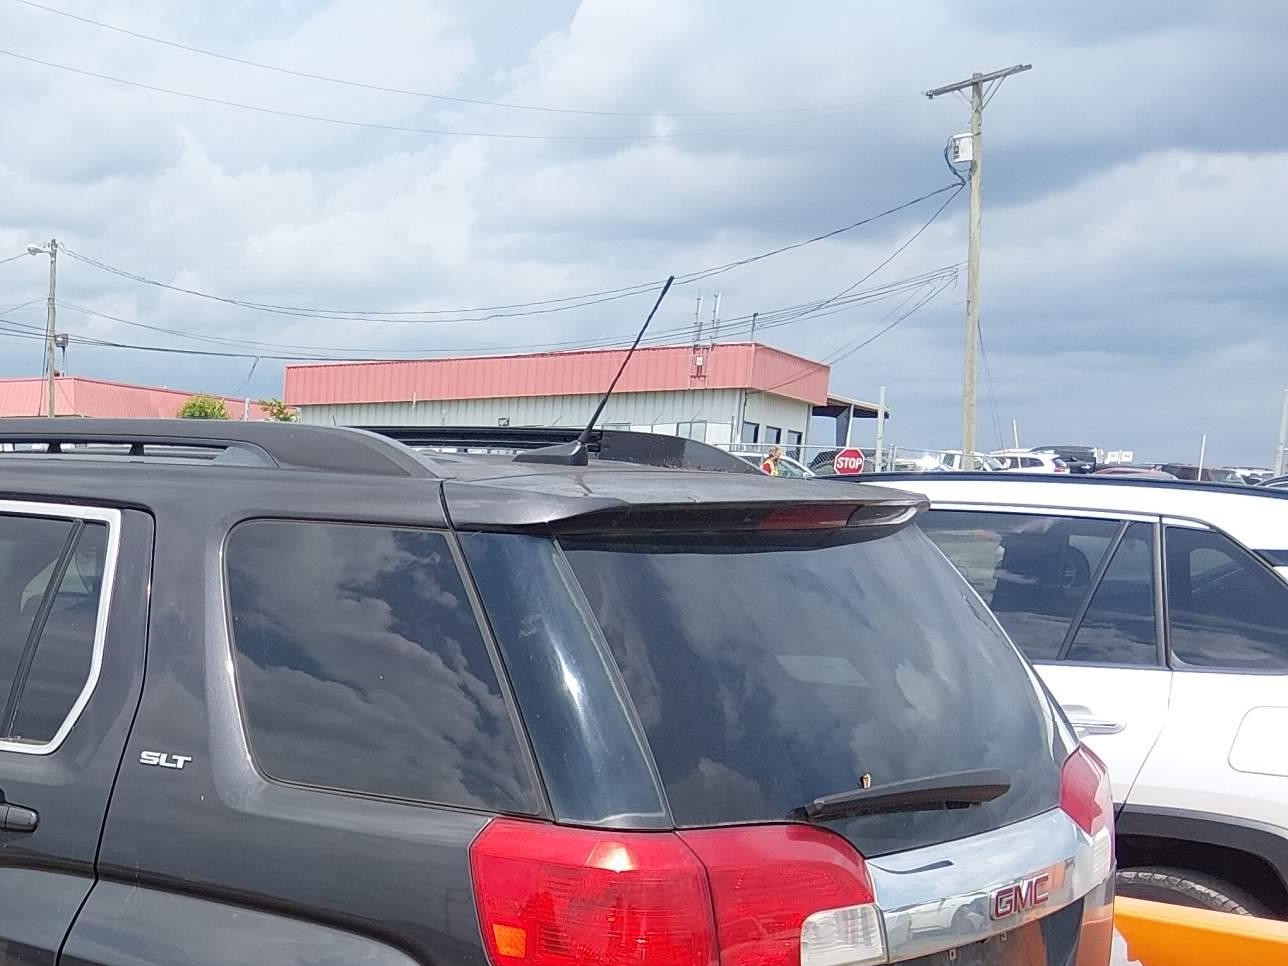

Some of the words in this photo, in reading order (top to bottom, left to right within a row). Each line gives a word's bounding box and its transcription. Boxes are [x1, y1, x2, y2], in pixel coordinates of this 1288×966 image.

[836, 456, 863, 469] STOP
[139, 750, 192, 769] SLT
[993, 871, 1049, 919] GMC
